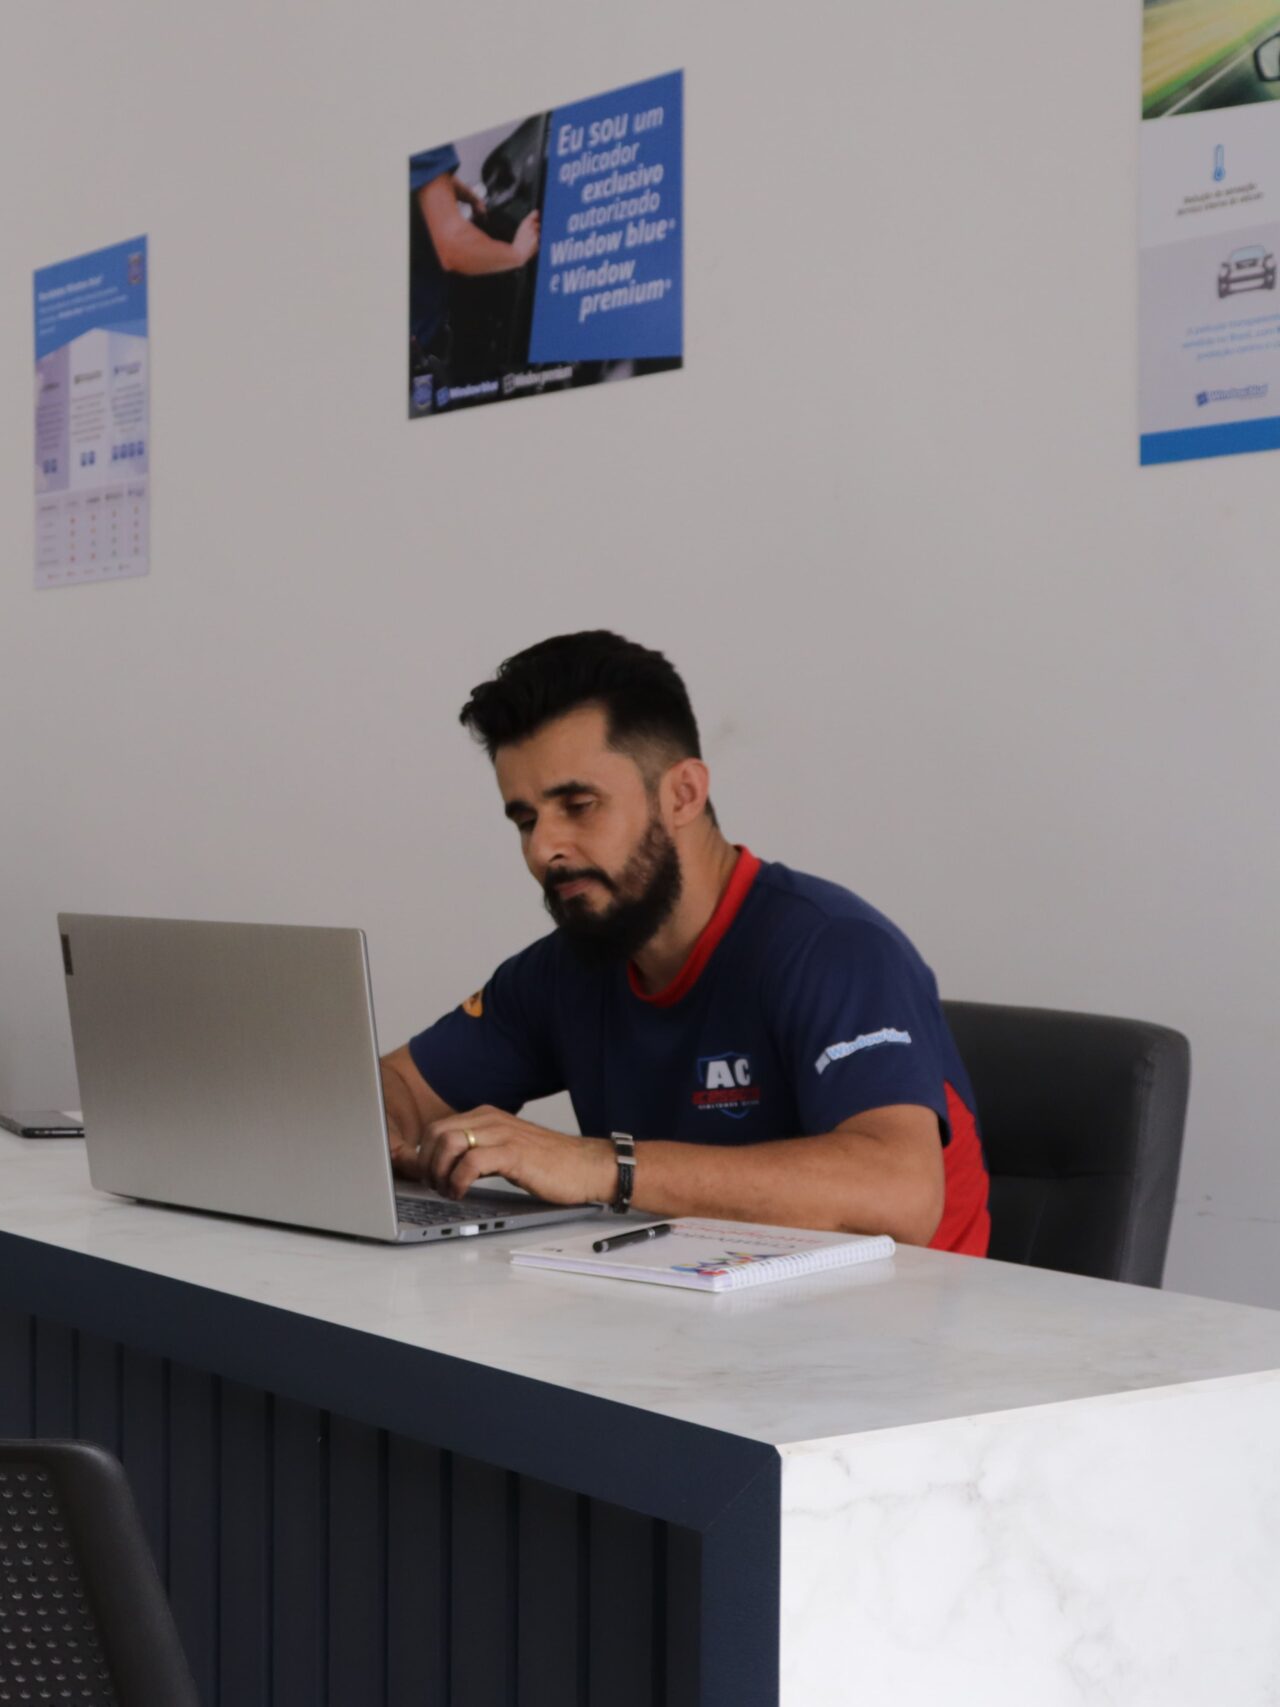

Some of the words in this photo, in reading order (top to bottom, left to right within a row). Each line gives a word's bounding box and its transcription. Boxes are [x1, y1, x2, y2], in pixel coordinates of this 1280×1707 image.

[557, 123, 584, 157] Eu
[634, 106, 665, 135] um
[560, 142, 640, 187] aplicador
[581, 162, 665, 201] exclusivo
[567, 188, 662, 233] autorizado
[550, 230, 623, 266] Window
[550, 273, 561, 293] e
[562, 259, 636, 294] Window
[706, 1059, 751, 1089] AC
